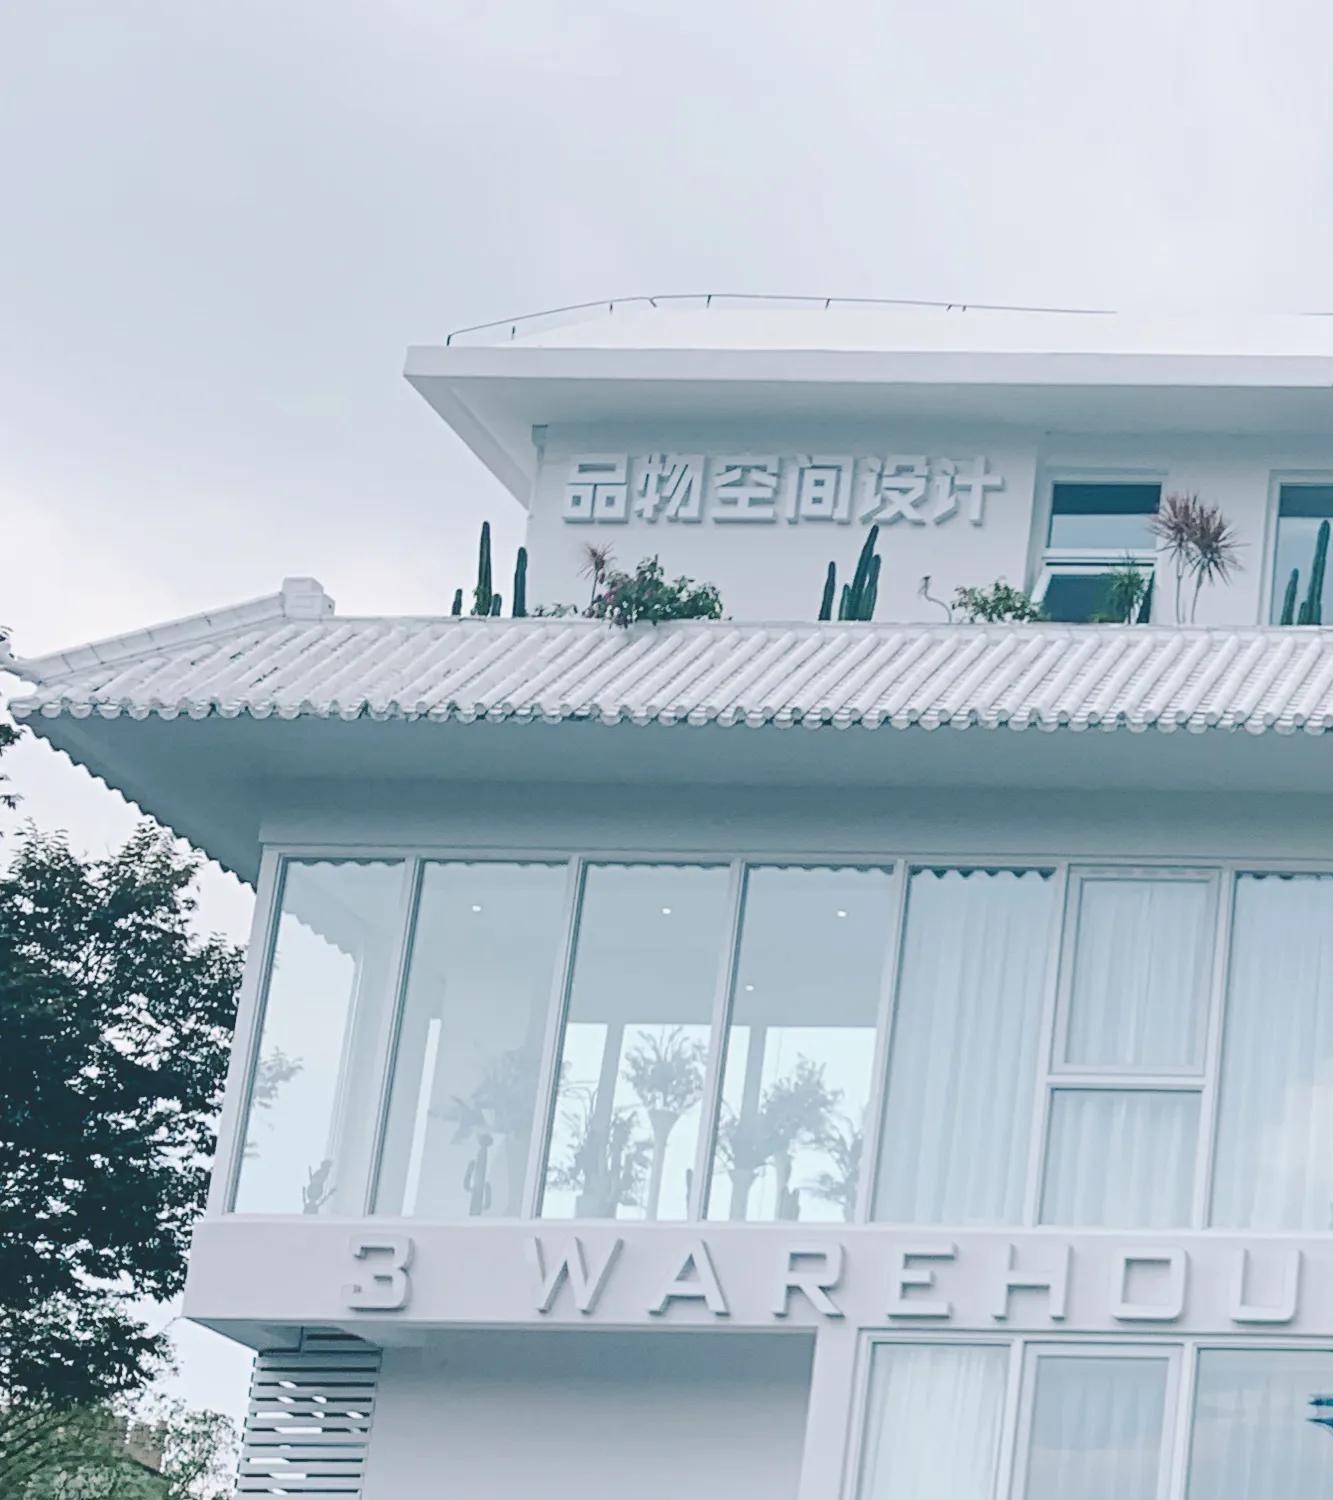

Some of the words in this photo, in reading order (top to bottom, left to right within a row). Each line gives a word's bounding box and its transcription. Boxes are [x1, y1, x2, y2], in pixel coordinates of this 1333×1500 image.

[561, 453, 1005, 526] 品物空间设计
[347, 1234, 414, 1311] 3
